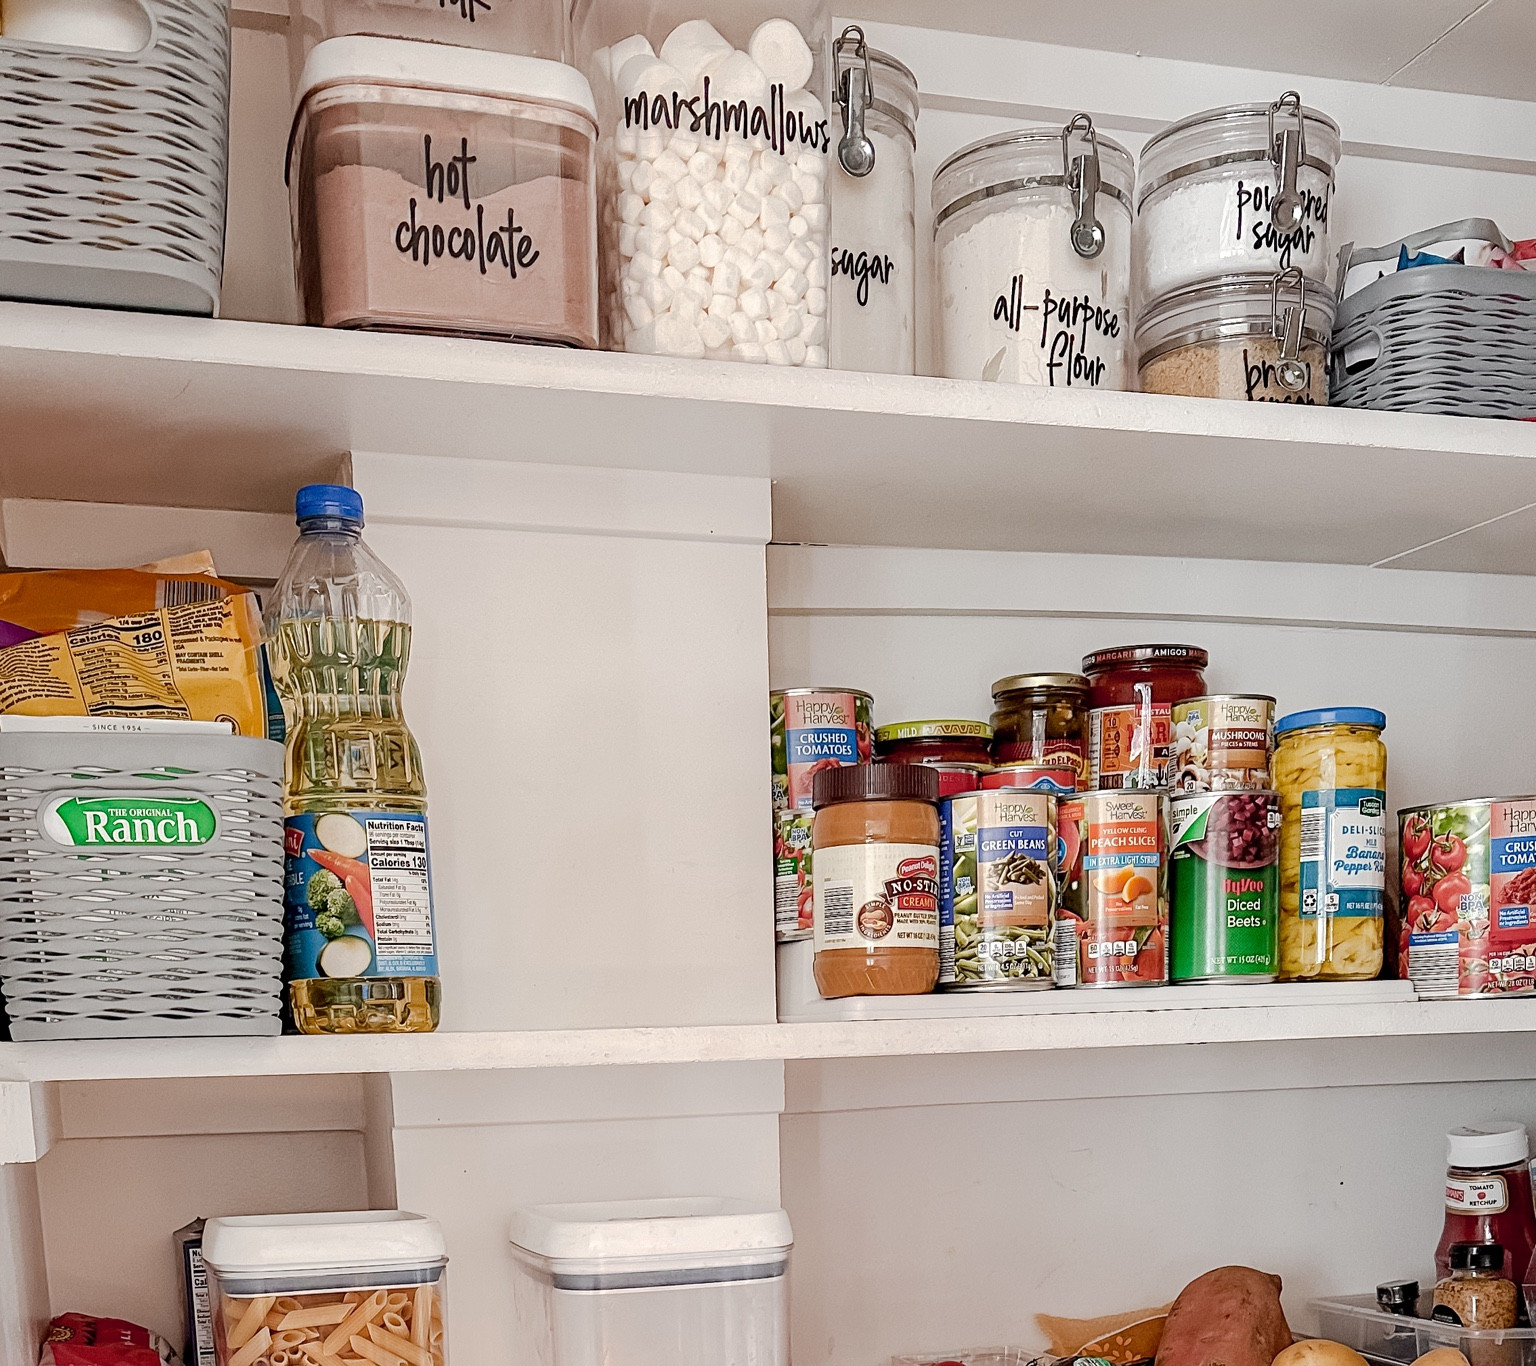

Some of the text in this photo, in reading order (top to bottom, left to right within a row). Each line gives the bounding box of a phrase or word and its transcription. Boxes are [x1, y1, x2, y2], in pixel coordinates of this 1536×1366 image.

[624, 76, 830, 156] marshmallows
[424, 134, 478, 210] hot
[1237, 180, 1330, 240] powred
[395, 197, 540, 280] chocolate
[1252, 221, 1316, 270] sugar
[831, 247, 894, 306] sugar
[993, 274, 1120, 360] all-purpose
[1046, 330, 1106, 386] flour
[70, 631, 162, 646] Calories 180
[1154, 649, 1188, 658] AMIGOS
[796, 701, 836, 714] Happy
[1222, 704, 1250, 714] Happy
[803, 713, 850, 726] Harvest
[1226, 713, 1262, 722] Harvest
[92, 723, 142, 732] SINCE 1954
[898, 728, 916, 738] MILD
[800, 733, 848, 744] CRUSHED
[1212, 731, 1265, 740] MUSHROOMS
[795, 745, 852, 756] TOMATOES
[1186, 782, 1194, 790] 20
[110, 808, 172, 817] THE ORIGINAL
[994, 802, 1027, 814] Happy
[1106, 802, 1136, 812] Sweet
[1172, 805, 1198, 818] simple
[1000, 813, 1038, 822] Harvest
[1110, 810, 1147, 820] Harvest
[84, 811, 200, 842] Ranch
[368, 822, 404, 830] Nutrition
[1103, 826, 1148, 836] YELLOW CLING
[791, 834, 806, 842] BPA
[1091, 836, 1156, 848] PEACH SLICES
[981, 839, 1046, 852] GREEN BEANS
[371, 856, 426, 868] Calories 130
[1089, 858, 1097, 866] IN
[1098, 857, 1120, 866] EXTRA
[1121, 856, 1140, 865] LIGHT
[1334, 860, 1372, 876] Pepper
[903, 897, 934, 908] CREAMY
[1460, 894, 1482, 902] NON
[865, 901, 887, 910] SIMPLE
[1228, 898, 1261, 911] Diced
[1346, 902, 1356, 910] NET
[1460, 901, 1484, 911] BPA
[1228, 916, 1261, 928] Beets
[860, 924, 892, 940] INGREDIENTS
[1211, 955, 1254, 966] NET WT 15 OZ
[1488, 981, 1498, 989] NET
[1516, 979, 1523, 987] OZ
[1529, 978, 1536, 986] LB
